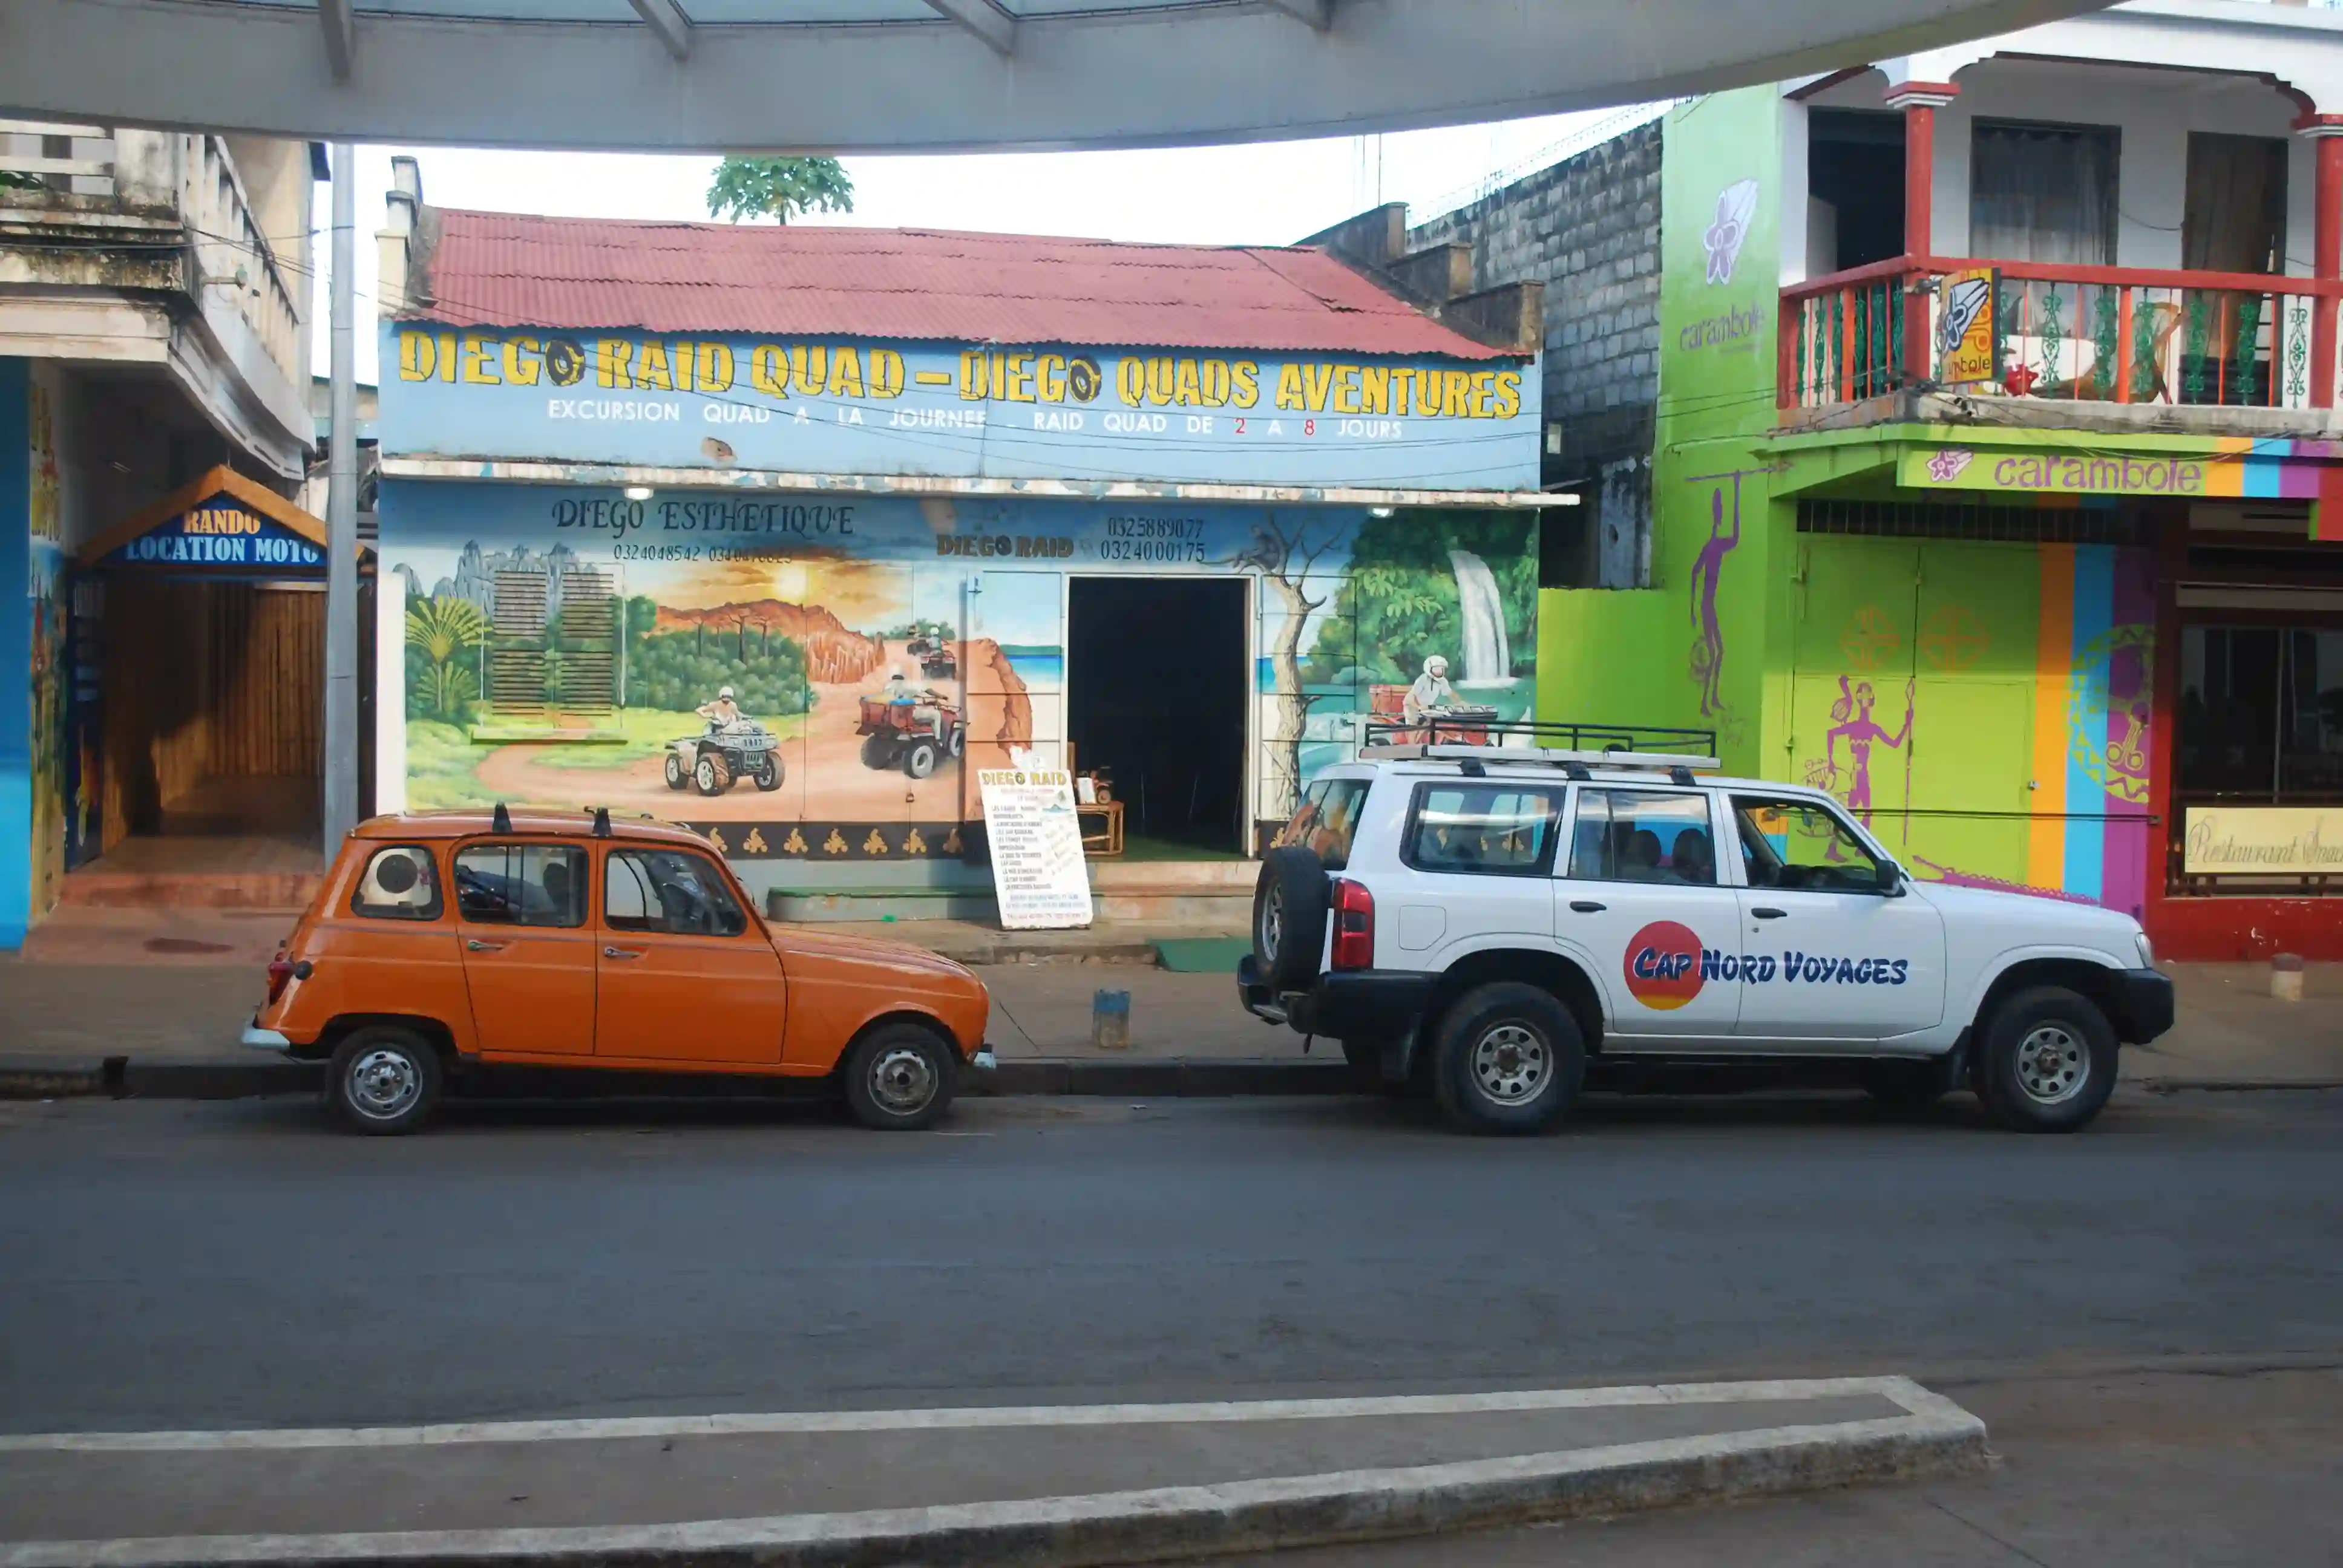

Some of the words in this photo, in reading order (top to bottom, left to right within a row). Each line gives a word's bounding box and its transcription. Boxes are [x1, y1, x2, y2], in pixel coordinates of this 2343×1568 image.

[1680, 299, 1765, 351] carambole
[399, 331, 585, 387] DIEGO
[597, 337, 734, 393] RAID
[750, 342, 905, 399] QUAD
[959, 350, 1102, 404] DIEGO
[1115, 356, 1260, 408] QUADS
[1275, 362, 1521, 419] AVENTURES
[548, 400, 680, 423] EXCURSION
[703, 403, 771, 424] QUAD
[794, 407, 810, 425] A
[837, 407, 863, 425] LA
[889, 408, 986, 428] JOURNEE
[1034, 410, 1084, 431] RAID
[1104, 413, 1167, 433] QUAD
[1187, 417, 1213, 434] DE
[1234, 417, 1245, 434] 2
[1267, 420, 1282, 436] A
[1304, 419, 1316, 436] 8
[1337, 420, 1402, 438] JOURS
[1994, 454, 2201, 492] carambole
[184, 509, 261, 534] RANDO
[552, 499, 644, 540] DIEGO
[658, 499, 854, 536] ESTHETIQUE
[1108, 517, 1204, 539] 0325889077
[126, 536, 246, 561] LOCATION
[255, 538, 319, 563] MOTO
[614, 544, 700, 562] 0324048542
[936, 534, 1012, 557] DIEGO
[1015, 535, 1074, 558] RAID
[1100, 540, 1205, 562] 0324000175
[981, 771, 1025, 786] DIEGO
[1029, 772, 1067, 786] RAID
[2186, 815, 2298, 863] Restaurant
[1699, 948, 1777, 985] NORD
[1784, 951, 1909, 985] VOYAGES
